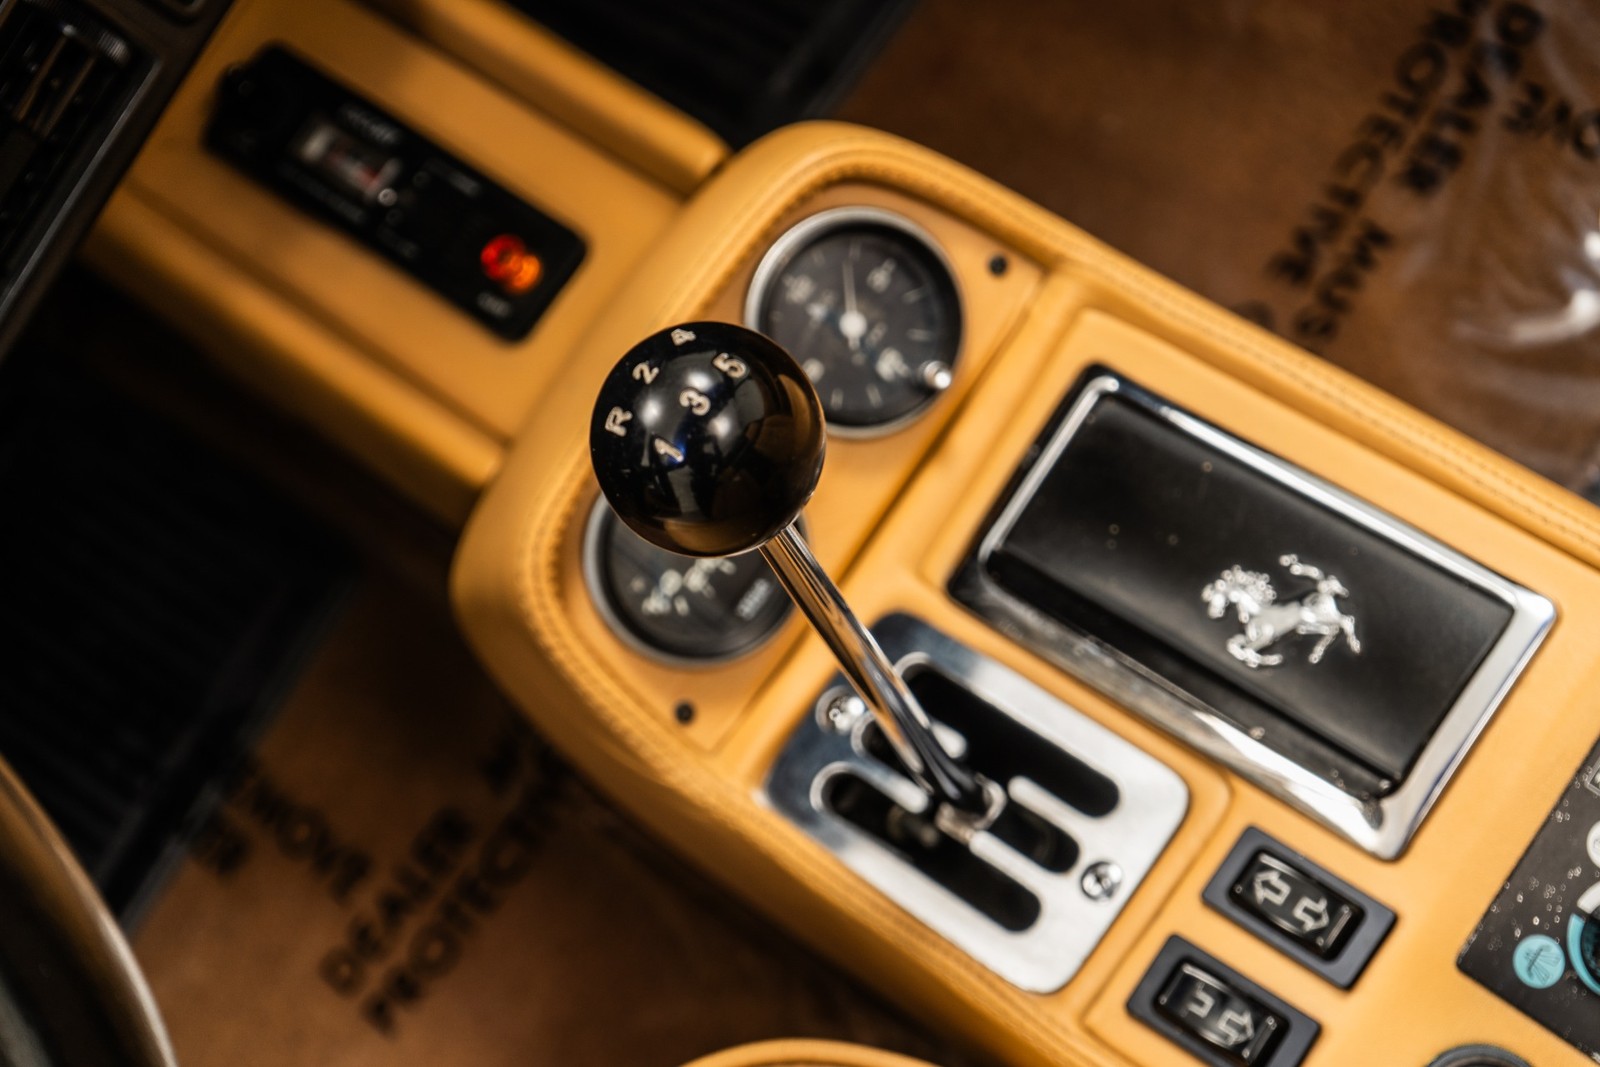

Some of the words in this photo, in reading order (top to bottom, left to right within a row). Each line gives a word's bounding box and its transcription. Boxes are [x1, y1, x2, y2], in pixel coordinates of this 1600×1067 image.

[604, 406, 633, 437] R
[632, 361, 660, 384] 2
[670, 328, 697, 346] 4
[654, 437, 684, 463] 1
[679, 387, 711, 416] 3
[712, 352, 747, 379] 5
